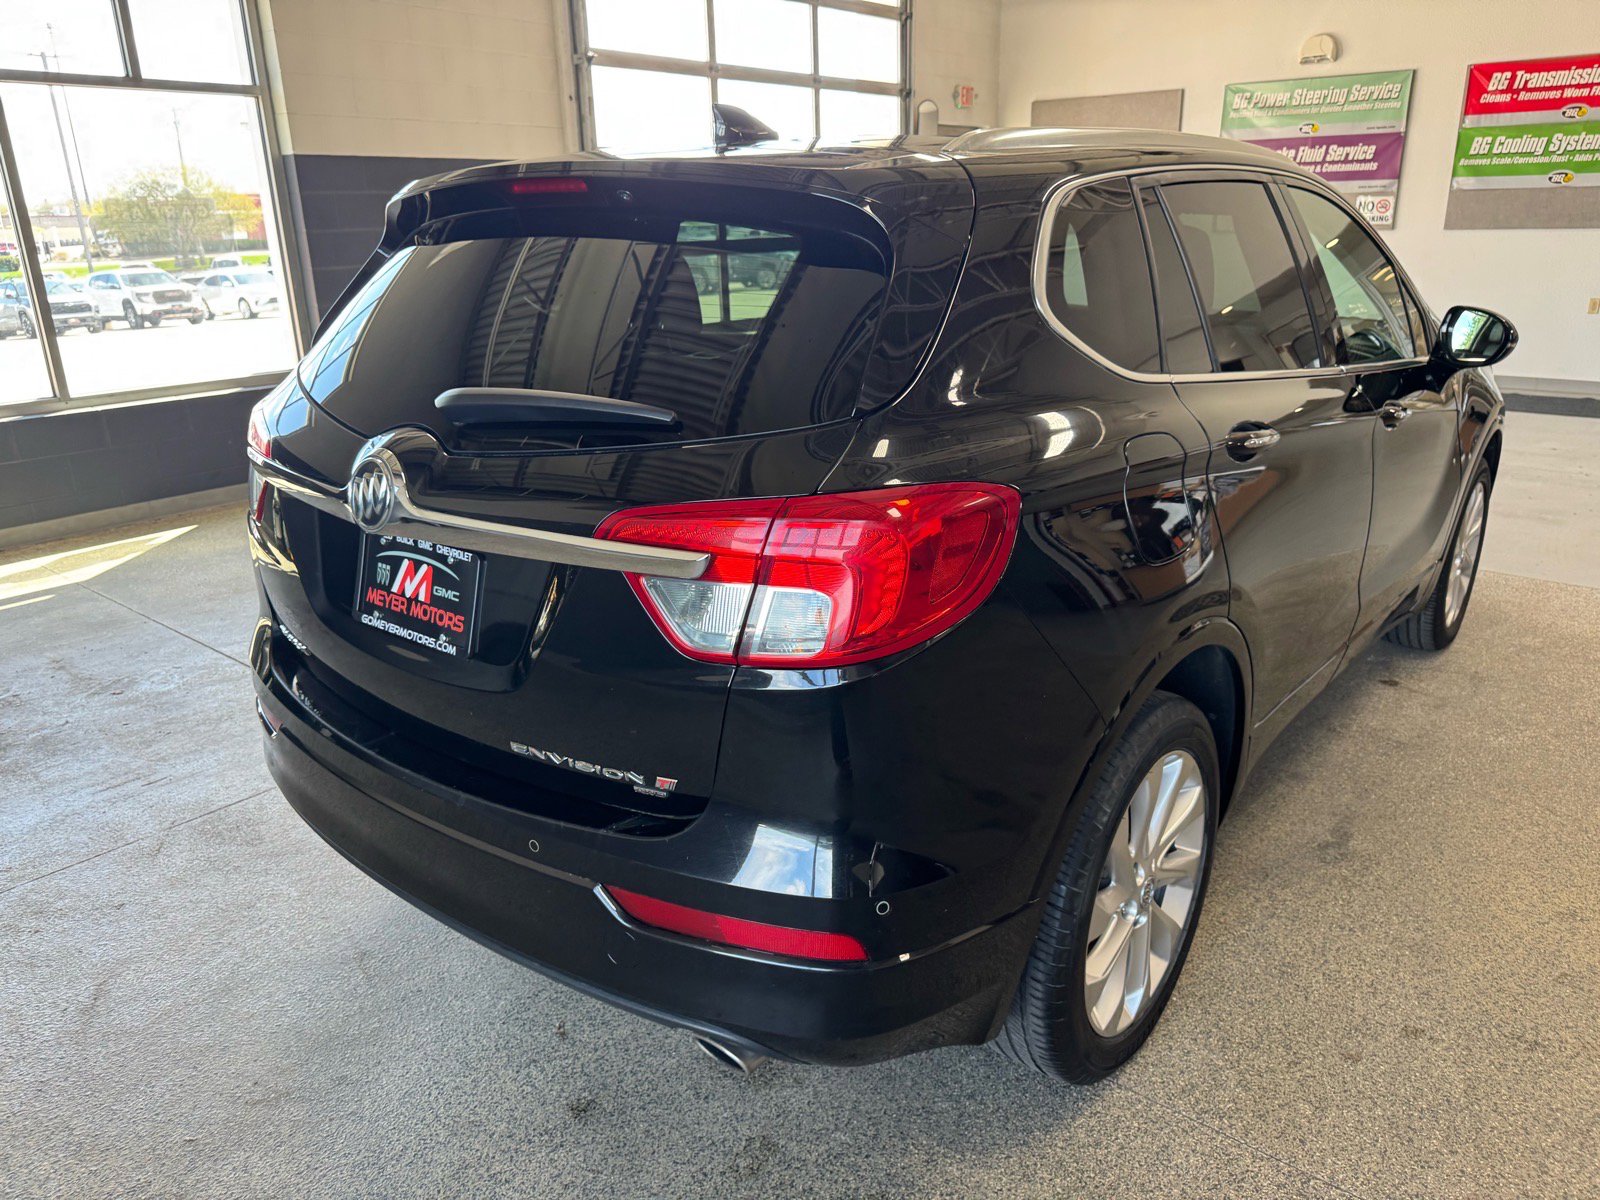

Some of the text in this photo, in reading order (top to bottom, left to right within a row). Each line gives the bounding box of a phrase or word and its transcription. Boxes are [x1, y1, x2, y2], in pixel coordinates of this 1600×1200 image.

[1488, 72, 1512, 91] BG
[960, 86, 974, 107] EXIT
[1233, 82, 1402, 110] BG Power Steering Service
[1480, 92, 1512, 103] Cleans
[1517, 89, 1563, 101] Removes
[1562, 87, 1591, 98] Worn
[1343, 102, 1374, 113] Smoother
[1374, 100, 1402, 110] Steering
[1296, 145, 1325, 163] Fluid
[1325, 142, 1377, 162] Service
[1470, 137, 1492, 155] BG
[1492, 134, 1549, 156] Cooling
[1322, 161, 1379, 172] Contaminants
[1459, 158, 1491, 166] Removes
[1491, 155, 1570, 165] Scale/Corrosion/Rust
[1572, 154, 1593, 162] Adds
[1358, 201, 1375, 212] NO
[417, 539, 433, 552] GMC
[436, 544, 473, 563] CHEVROLET
[433, 585, 460, 602] GMC
[365, 586, 465, 633] MEYER MOTORS
[361, 614, 457, 656] GOMEYERMOTORS.COM
[509, 741, 647, 786] ENVISION
